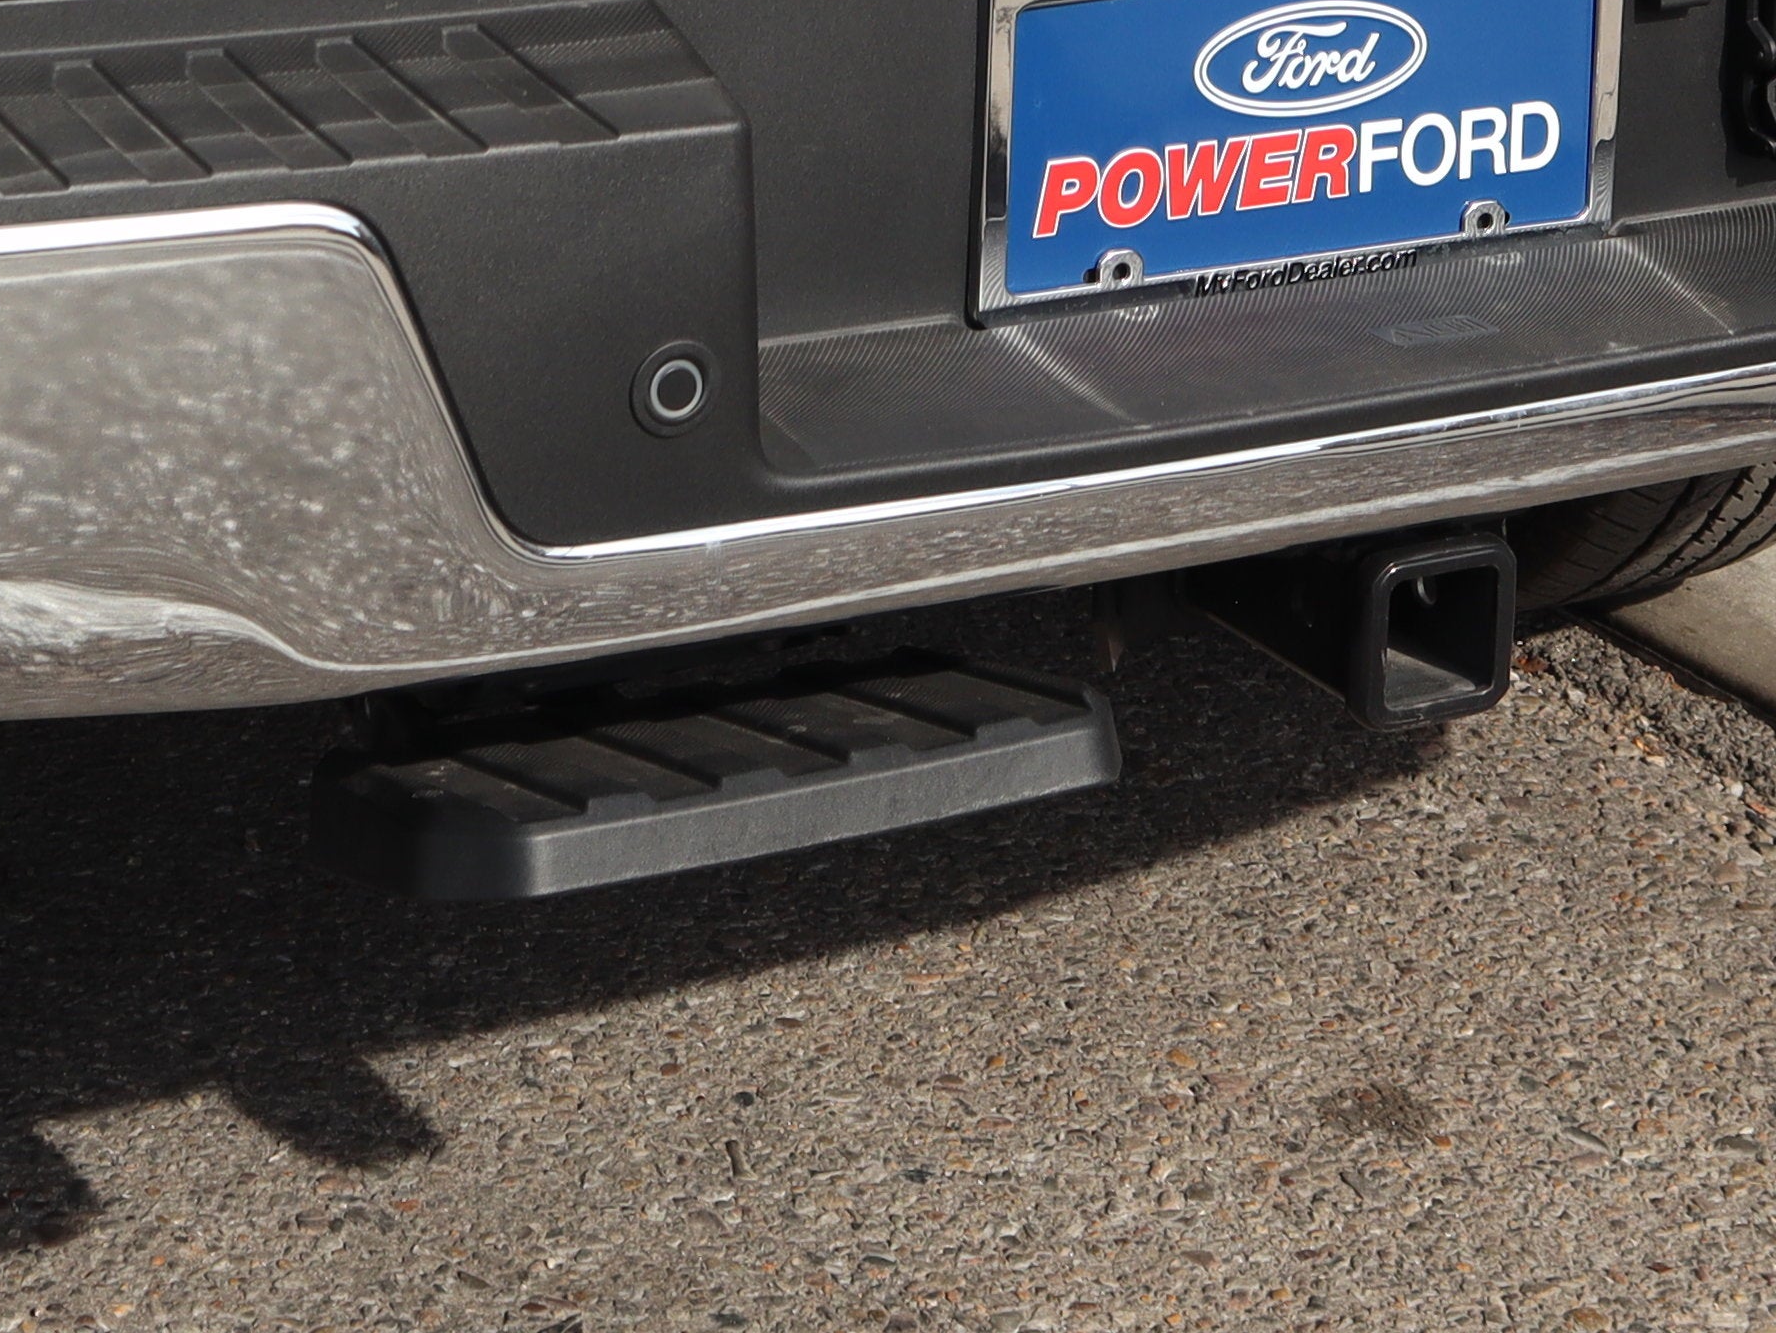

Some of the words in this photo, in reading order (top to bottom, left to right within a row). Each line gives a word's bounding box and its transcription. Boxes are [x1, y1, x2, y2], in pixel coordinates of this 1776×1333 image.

[1241, 18, 1381, 94] Ford
[1031, 100, 1561, 239] POWERFORD
[1193, 247, 1418, 299] MyFordDealer.com
